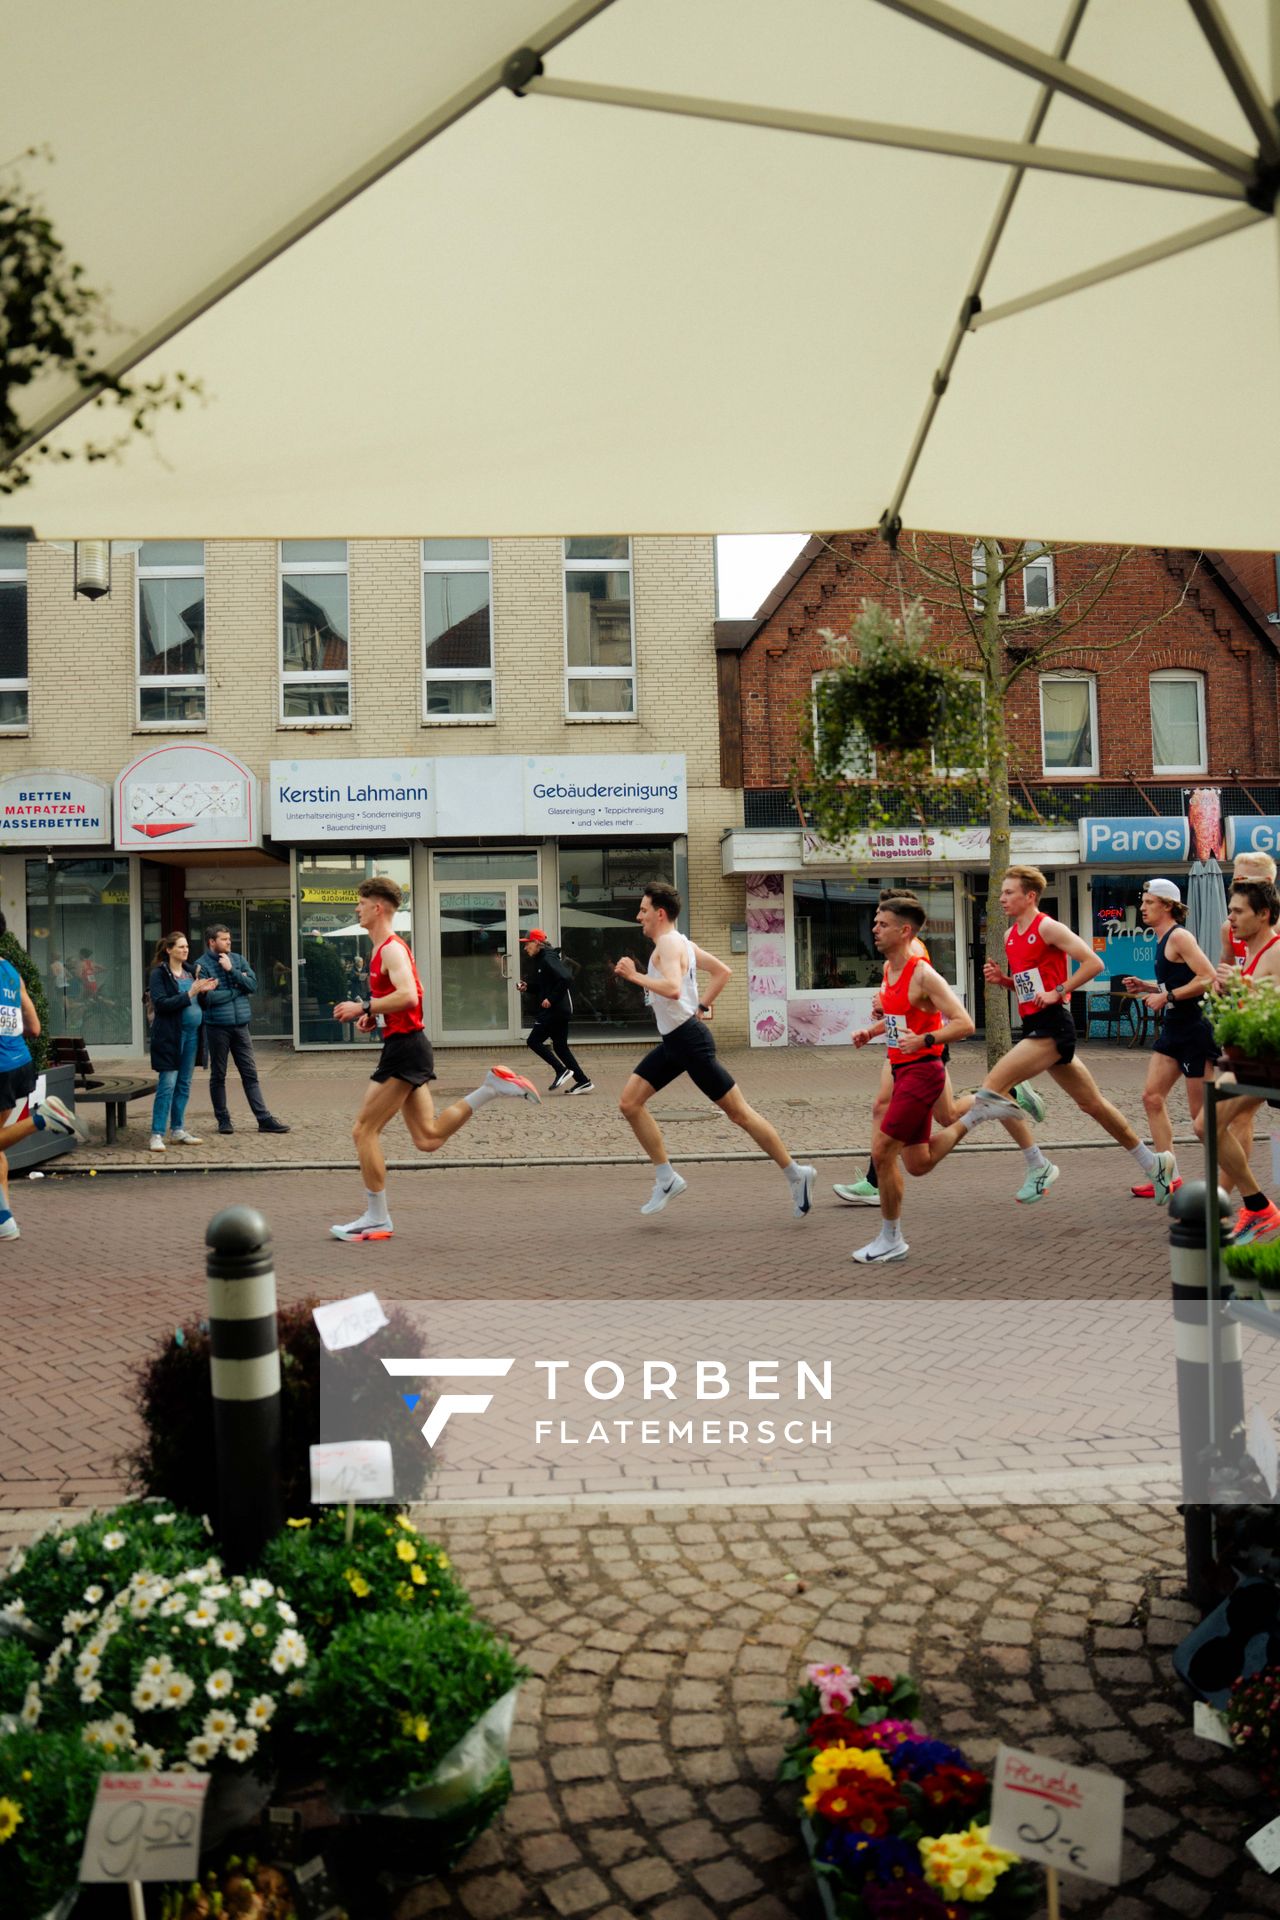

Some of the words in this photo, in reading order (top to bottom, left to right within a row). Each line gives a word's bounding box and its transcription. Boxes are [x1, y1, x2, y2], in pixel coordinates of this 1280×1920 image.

[19, 791, 71, 801] BETTEN
[279, 785, 340, 803] Kerstin
[347, 784, 428, 801] Lahmann
[533, 783, 678, 800] Gebäudereinigung
[5, 804, 86, 815] MATRATZEN
[547, 807, 596, 816] Glasreinigung
[604, 806, 664, 816] Teppichreinigung
[286, 811, 355, 821] Unterhaltsreinigung
[362, 810, 421, 820] Sonderreinigung
[0, 817, 100, 829] ASSERBETTEN
[577, 819, 592, 827] und
[593, 818, 613, 827] vieles
[615, 818, 634, 827] mehr
[868, 835, 894, 847] Lila
[1091, 824, 1181, 852] Paros
[871, 847, 932, 858] Nagelstudio
[1099, 909, 1122, 918] OPEN
[1102, 919, 1159, 945] Paro
[1015, 972, 1030, 984] GLS
[0, 1006, 17, 1017] GLS
